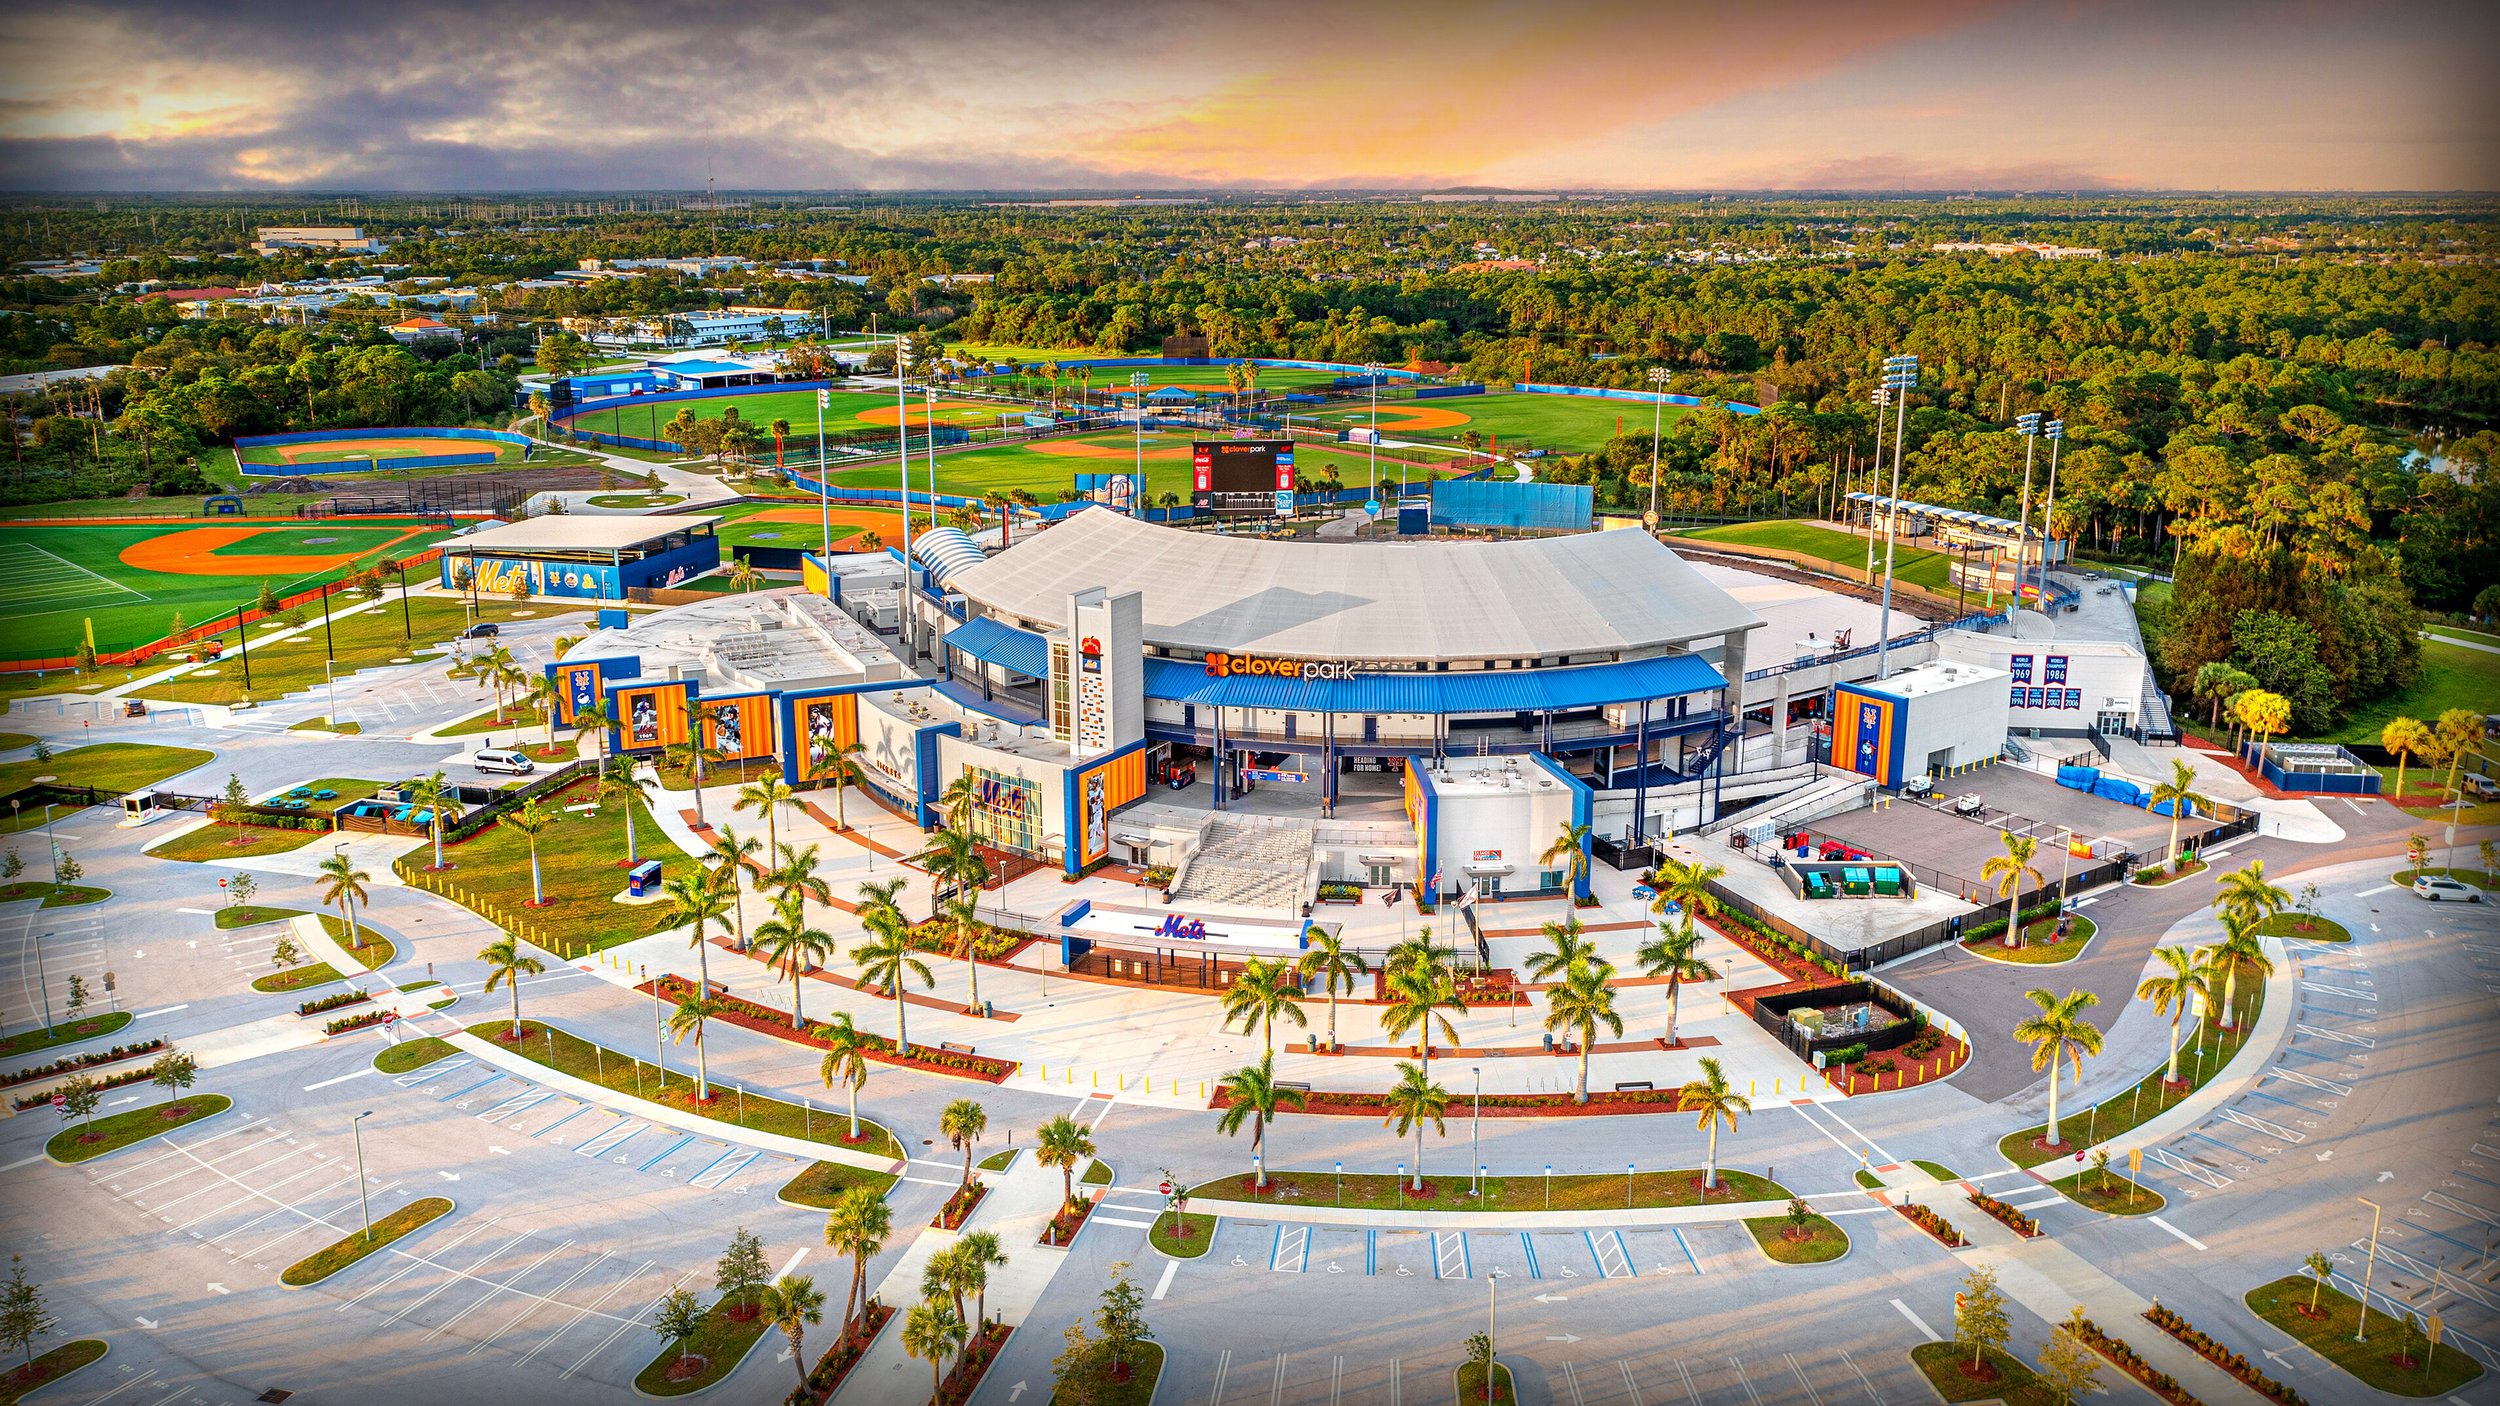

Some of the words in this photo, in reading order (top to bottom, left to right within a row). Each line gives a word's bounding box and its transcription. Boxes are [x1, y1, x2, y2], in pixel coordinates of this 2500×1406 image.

[665, 565, 685, 587] Mets
[2012, 669, 2031, 679] 1969
[2046, 670, 2065, 680] 1986
[2029, 698, 2043, 706] 1998
[2065, 699, 2079, 707] 2006
[876, 759, 901, 780] TICKETS
[1353, 764, 1364, 772] FOR
[1364, 764, 1382, 772] HOME!
[1154, 913, 1207, 941] Mets
